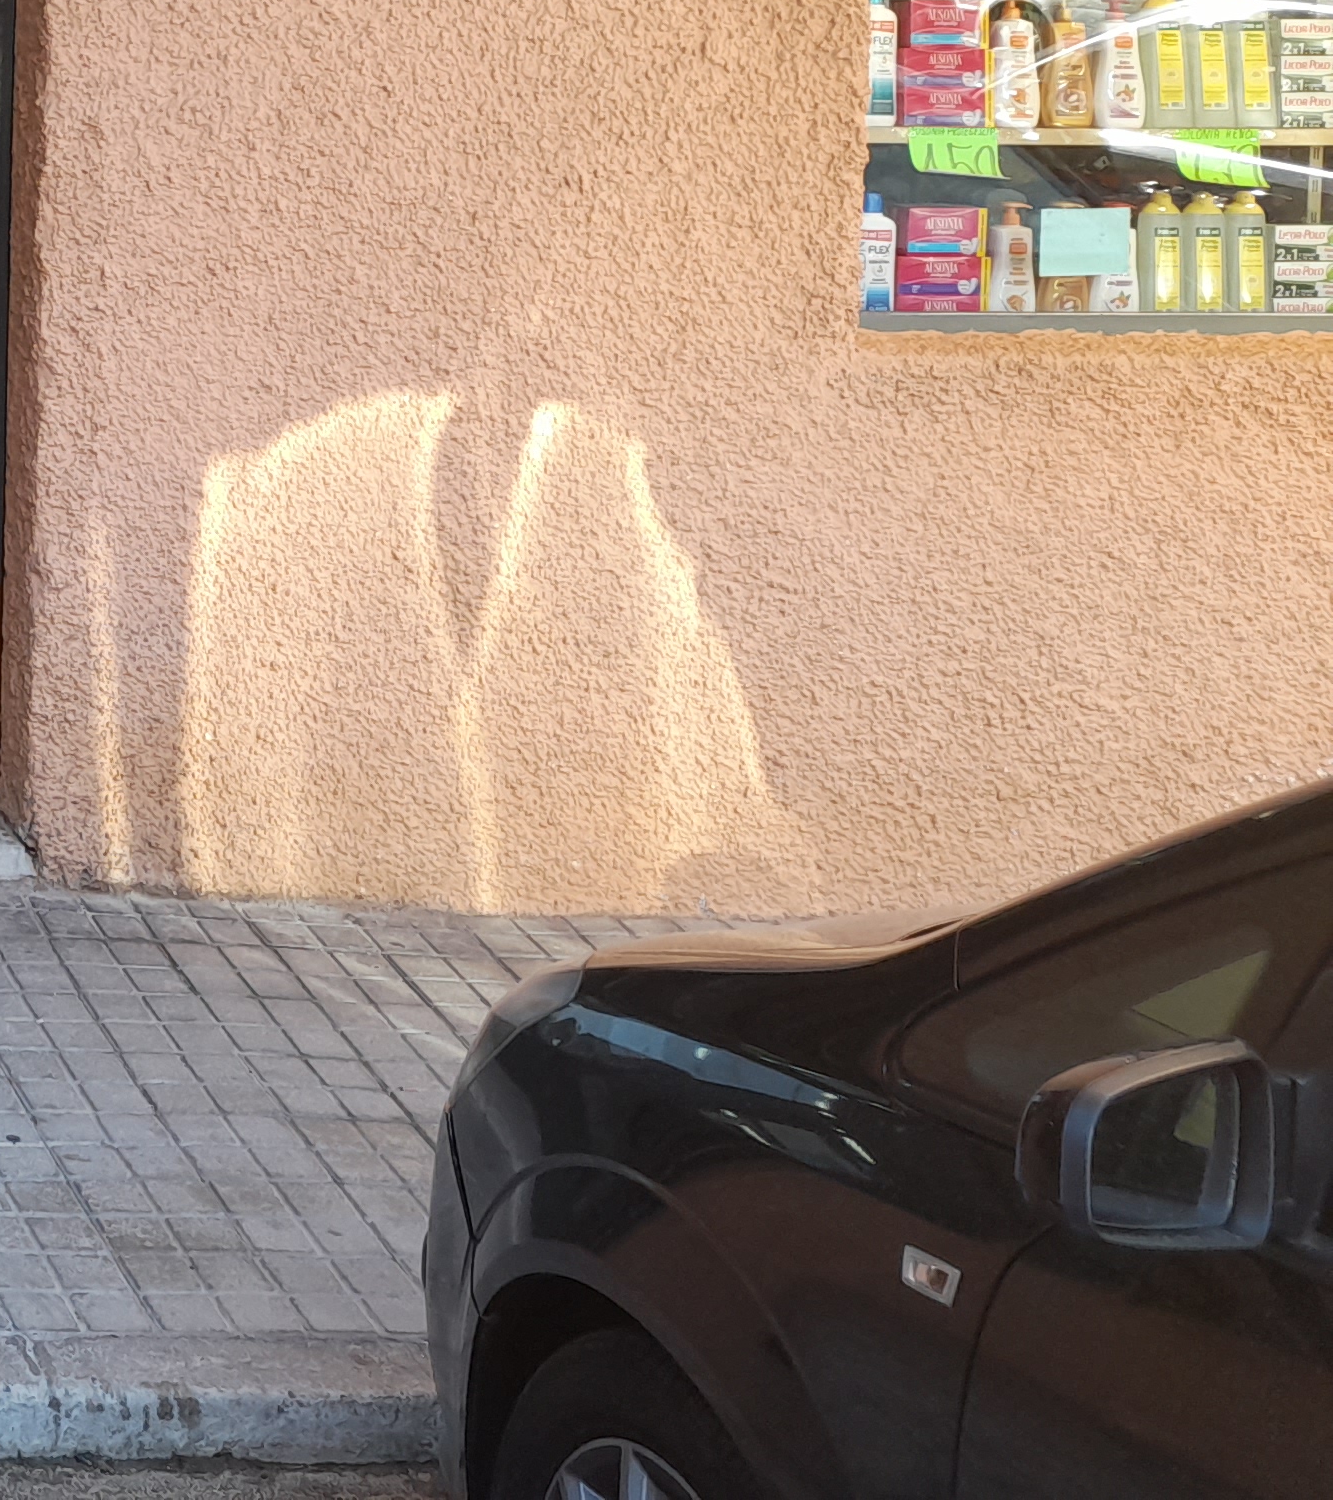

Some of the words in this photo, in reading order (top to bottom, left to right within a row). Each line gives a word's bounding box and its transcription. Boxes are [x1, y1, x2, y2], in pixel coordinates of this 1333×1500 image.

[927, 7, 966, 22] AUSONIA
[1283, 22, 1308, 34] LICOR
[1309, 22, 1331, 34] POLO
[873, 35, 894, 45] FLEX
[1283, 43, 1305, 55] 2x1
[928, 53, 962, 65] AUSONIA
[1283, 59, 1308, 70] LICOR
[1309, 59, 1331, 70] POLO
[1282, 79, 1304, 91] 2x1
[928, 92, 962, 105] AUSONIA
[1284, 96, 1308, 106] LICOR
[1309, 96, 1331, 106] POLO
[1283, 115, 1305, 127] 2x1
[925, 217, 964, 230] AUSONIA
[1303, 230, 1325, 239] POLO
[868, 244, 891, 255] FLEX
[1276, 249, 1298, 260] 2x1
[924, 261, 959, 274] AUSONIA
[1277, 266, 1301, 276] LICOR
[1275, 285, 1296, 296] 2x1
[923, 300, 957, 311] AUSONIA
